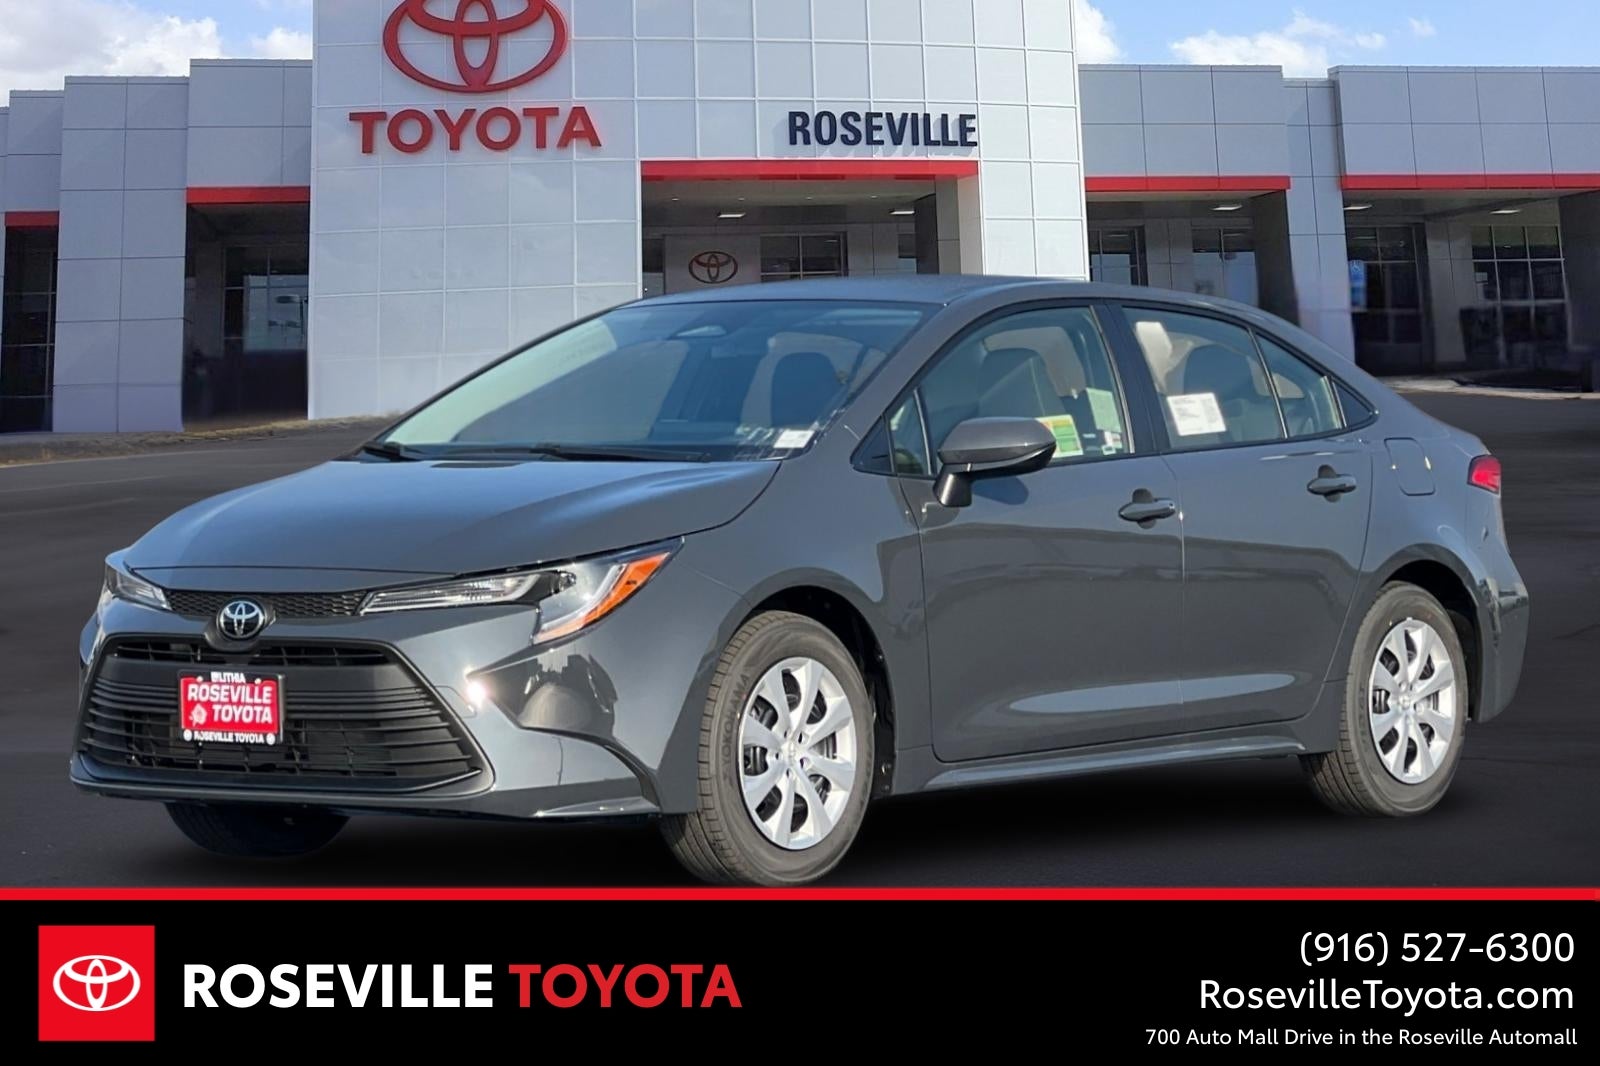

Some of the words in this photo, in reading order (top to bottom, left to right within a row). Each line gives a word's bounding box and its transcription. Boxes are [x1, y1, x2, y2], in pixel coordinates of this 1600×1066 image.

[349, 106, 602, 154] TOYOTA
[788, 111, 978, 147] ROSEVILLE
[187, 683, 273, 704] ROSEVILLE
[212, 704, 273, 724] TOYOTA
[194, 730, 234, 742] ROSEVILLE
[235, 733, 265, 744] TOYOTA
